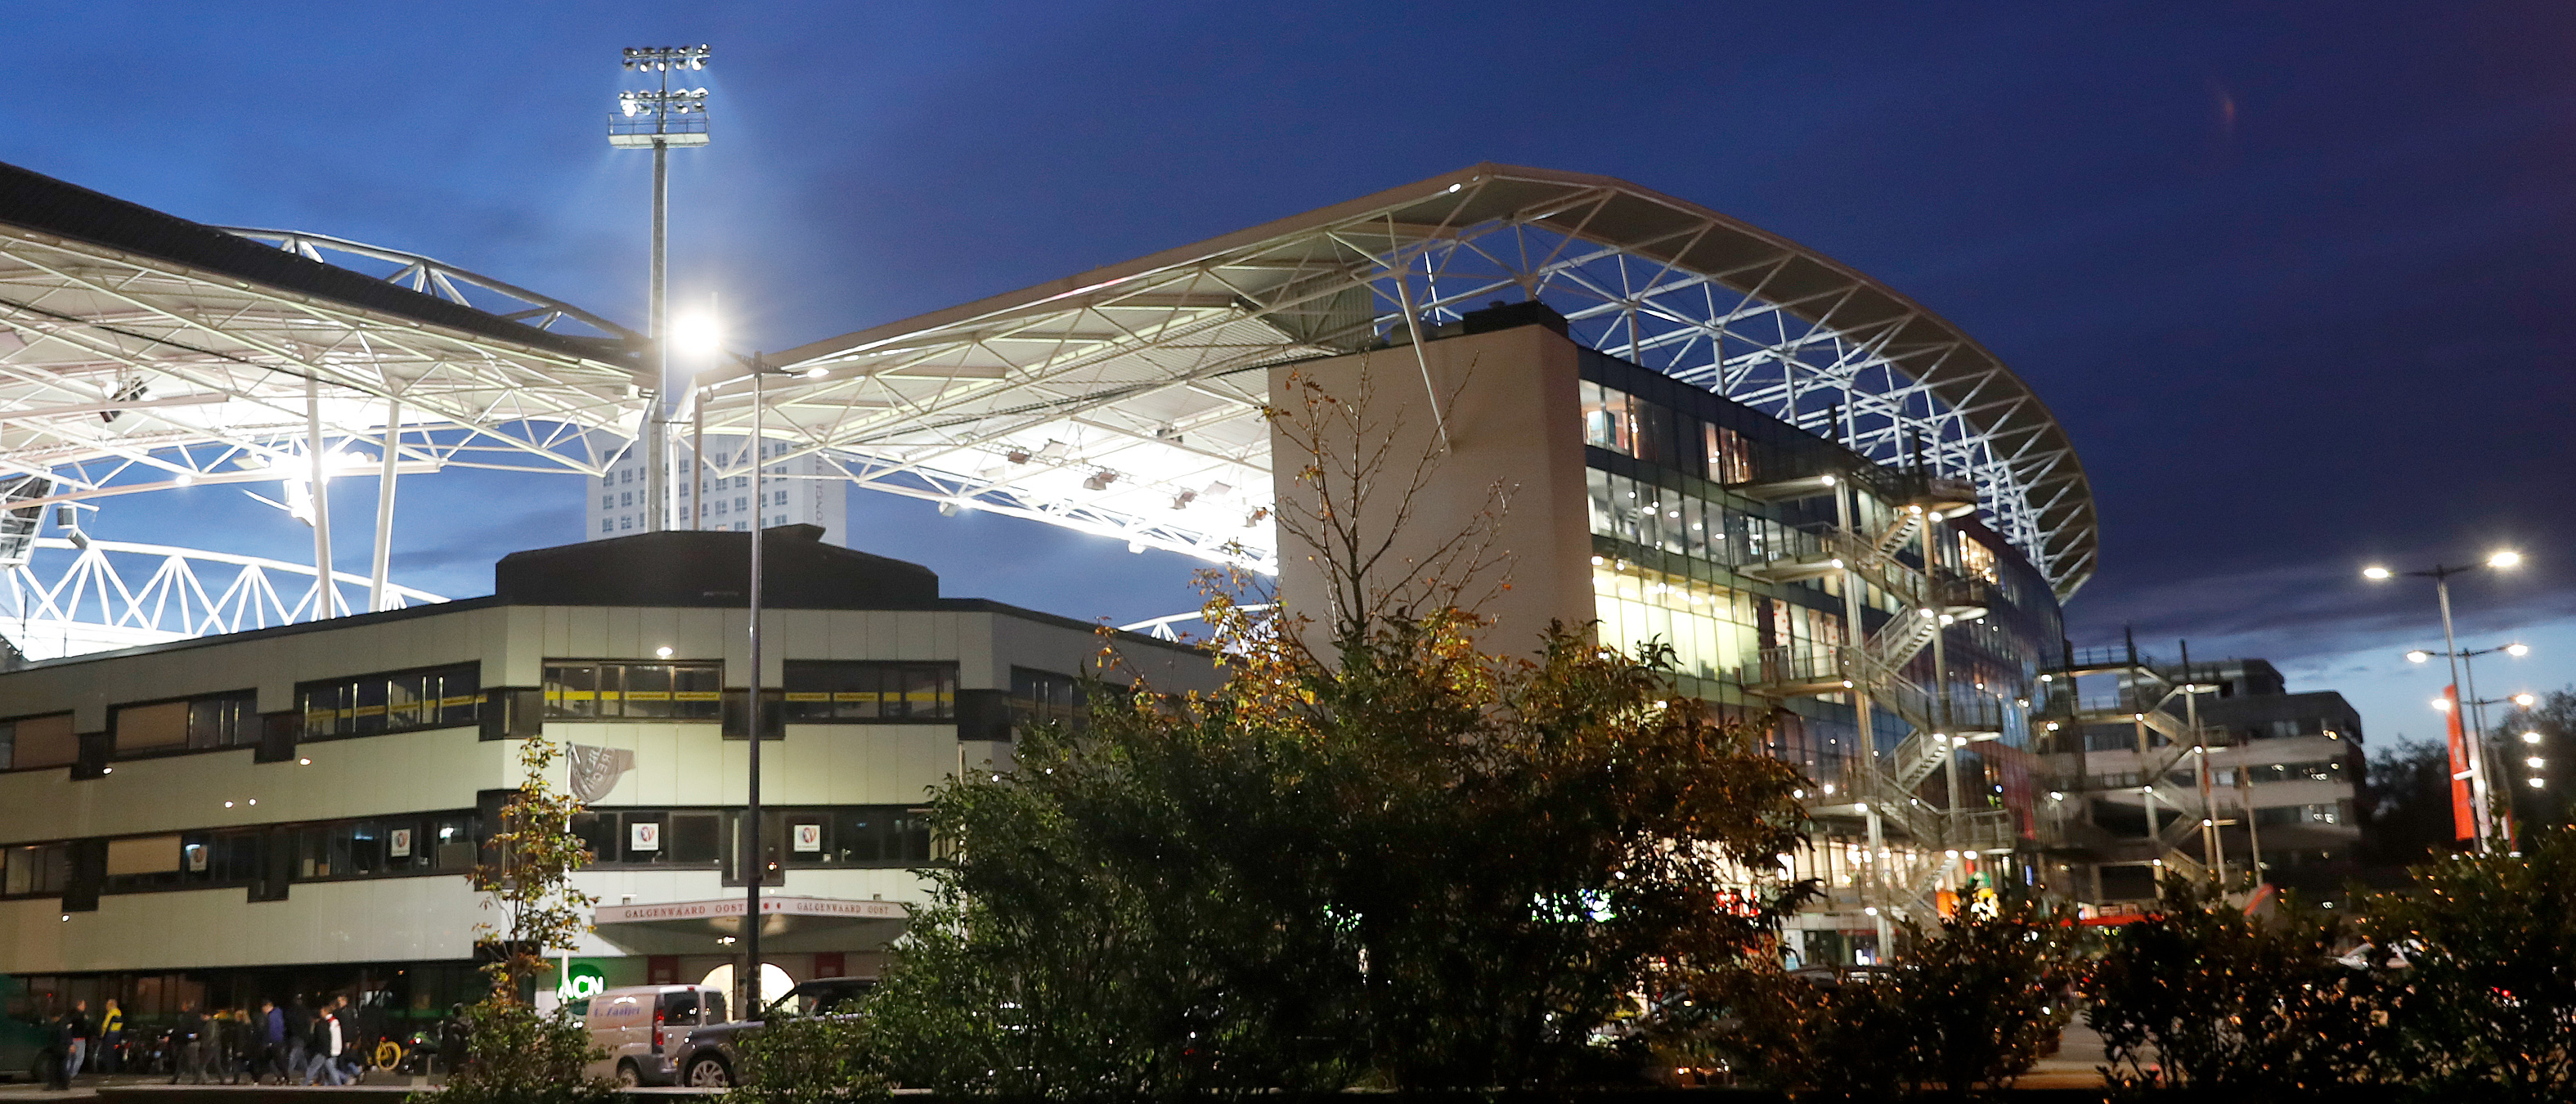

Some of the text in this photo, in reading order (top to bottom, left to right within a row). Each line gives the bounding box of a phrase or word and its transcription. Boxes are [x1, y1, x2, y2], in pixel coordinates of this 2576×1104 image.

[625, 903, 744, 918] GALGENWAARD OOST
[797, 902, 889, 915] GALGENWAARD OOST
[557, 975, 604, 999] ACN
